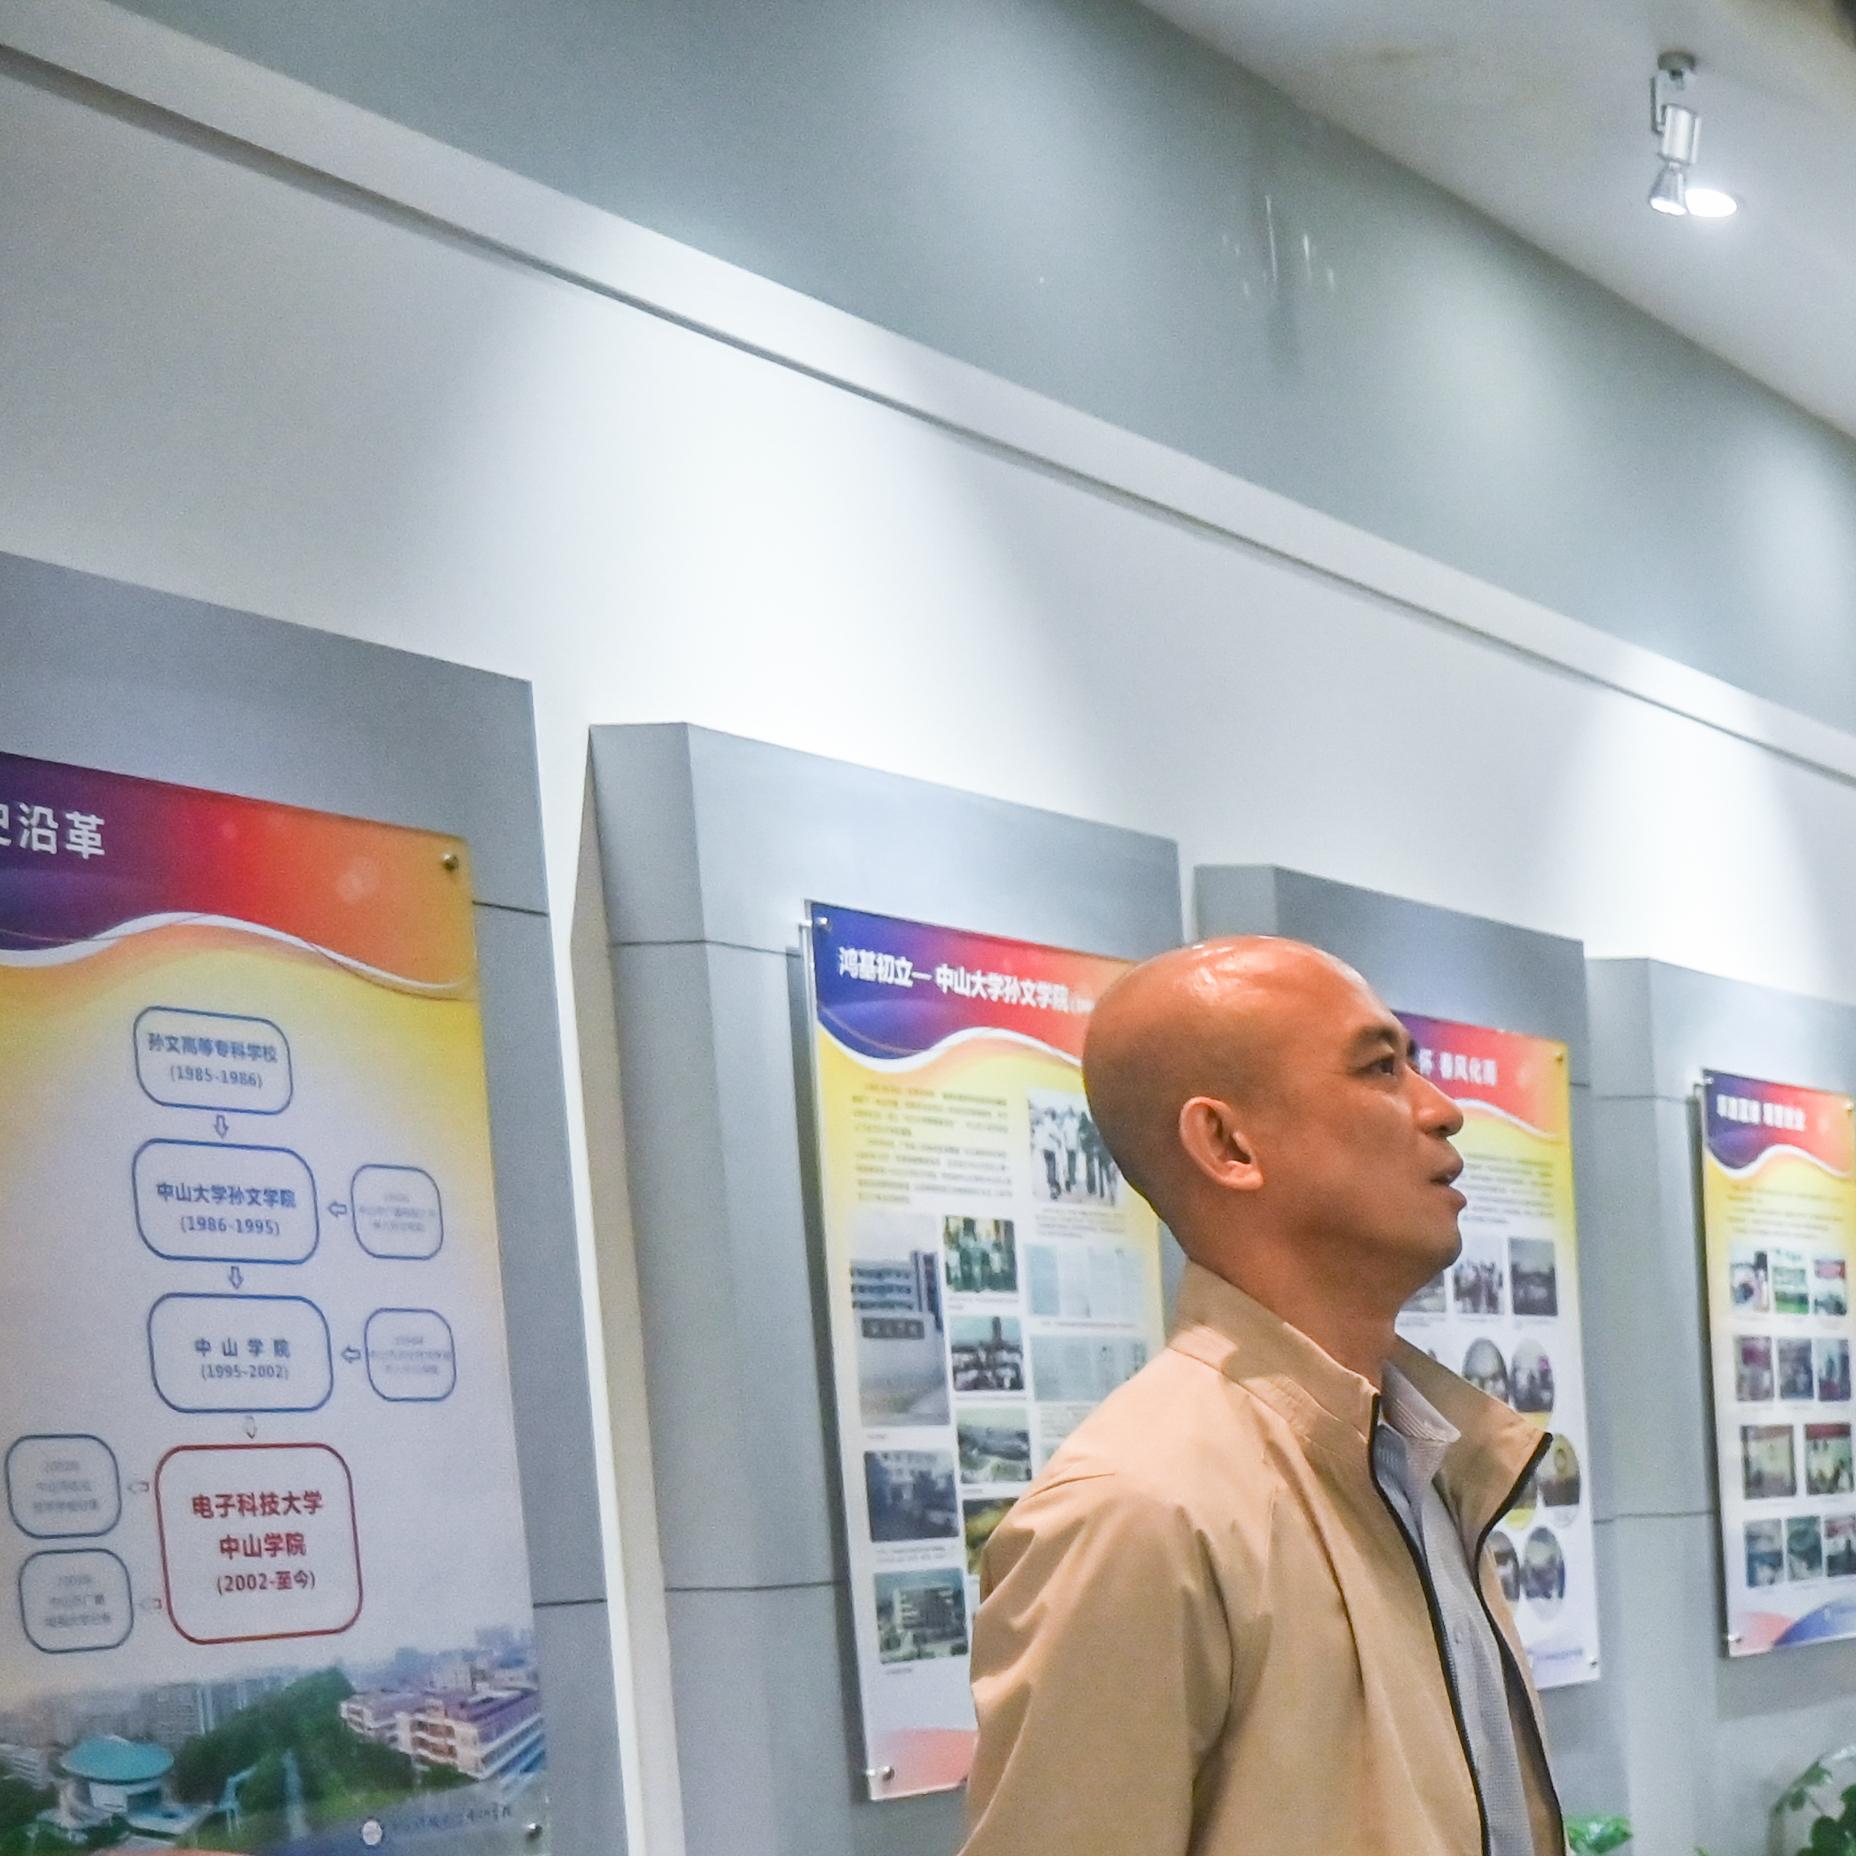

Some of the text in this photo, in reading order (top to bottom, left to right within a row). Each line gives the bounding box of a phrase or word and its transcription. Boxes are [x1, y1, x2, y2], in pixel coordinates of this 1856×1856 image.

[0, 801, 105, 859] 沿革
[156, 1181, 297, 1209] 中山大学孙文学院
[191, 1490, 324, 1520] 电子科技大学
[218, 1533, 307, 1562] 中山学院
[216, 1571, 316, 1596] (2002-至今)
